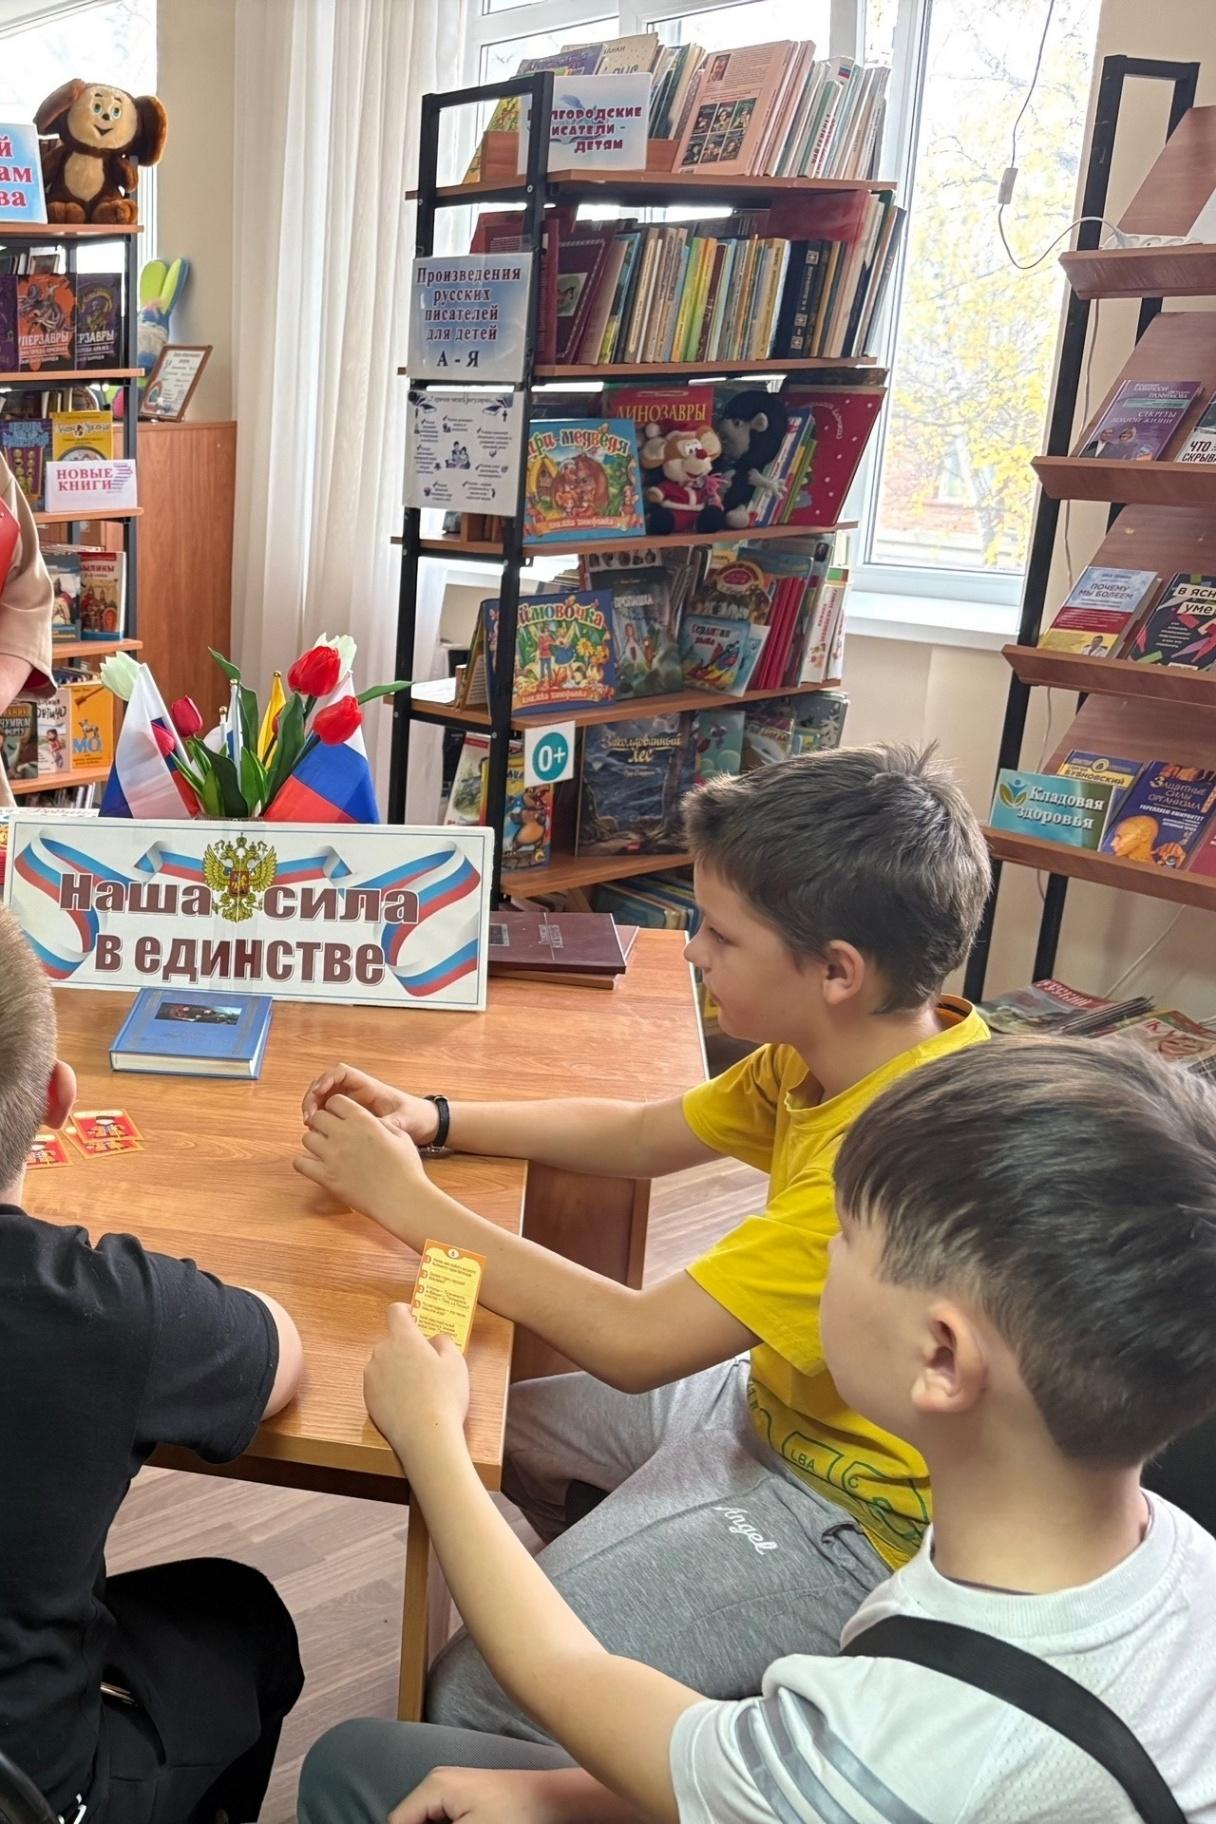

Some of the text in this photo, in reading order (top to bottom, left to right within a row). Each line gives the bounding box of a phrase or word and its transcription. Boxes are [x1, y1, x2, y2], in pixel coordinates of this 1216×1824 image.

[528, 107, 642, 123] ЛГОРОДСКИЕ
[552, 123, 614, 135] ИСАТЕЛИ
[575, 139, 624, 153] ДЕТЯМ
[416, 267, 521, 287] Произведения
[433, 289, 490, 305] русских
[425, 305, 498, 321] писателей
[426, 325, 497, 341] для детей
[436, 350, 448, 366] А
[466, 350, 480, 367] Я
[1190, 441, 1212, 452] ЧТО
[57, 468, 113, 480] НОВЫЕ
[58, 480, 112, 492] КНИГИ
[1090, 583, 1130, 592] ПОЧЕМУ
[1095, 590, 1134, 600] БОЛЕЕМ
[1189, 589, 1216, 598] ЯСН
[538, 745, 566, 772] 0+
[1029, 785, 1105, 811] Кладовая
[1016, 806, 1095, 829] здоровья
[59, 872, 419, 924] Наша сила
[96, 934, 385, 986] в единстве
[790, 1450, 815, 1473] LBA
[712, 1505, 779, 1555] Angel
